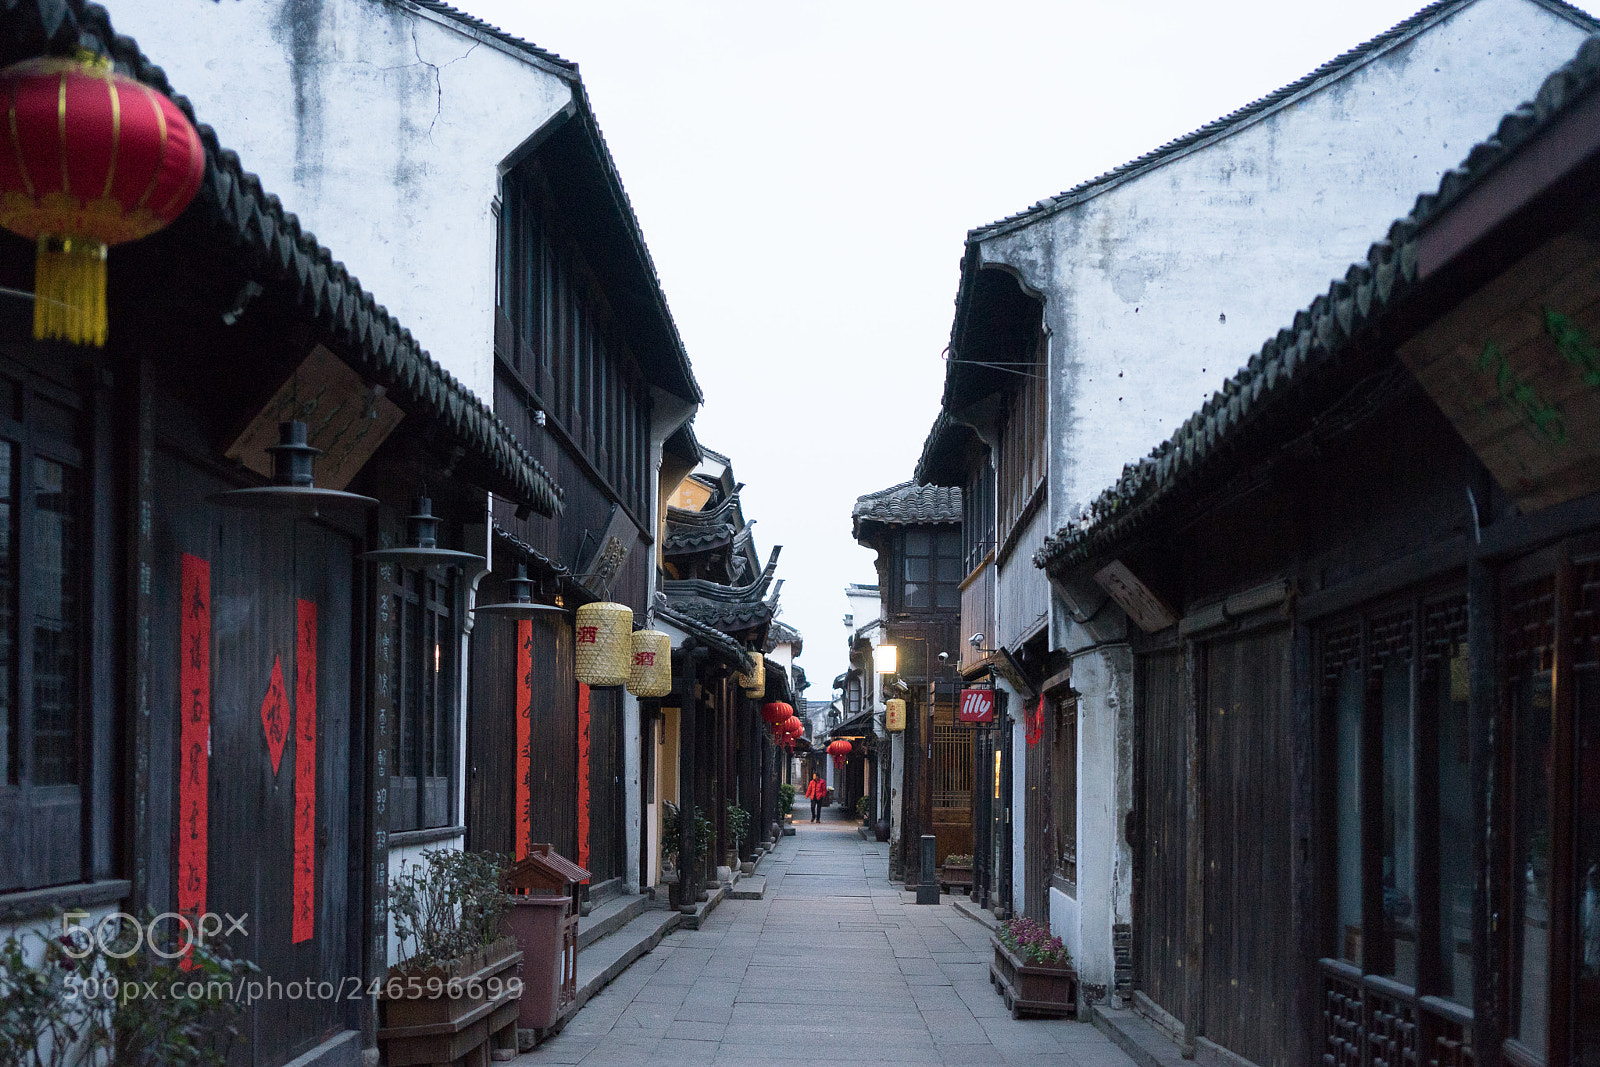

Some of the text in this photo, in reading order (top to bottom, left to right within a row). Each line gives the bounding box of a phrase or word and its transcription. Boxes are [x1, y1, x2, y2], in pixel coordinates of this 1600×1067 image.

[578, 626, 598, 644] 酒
[635, 652, 655, 666] 酒
[963, 693, 991, 717] illy
